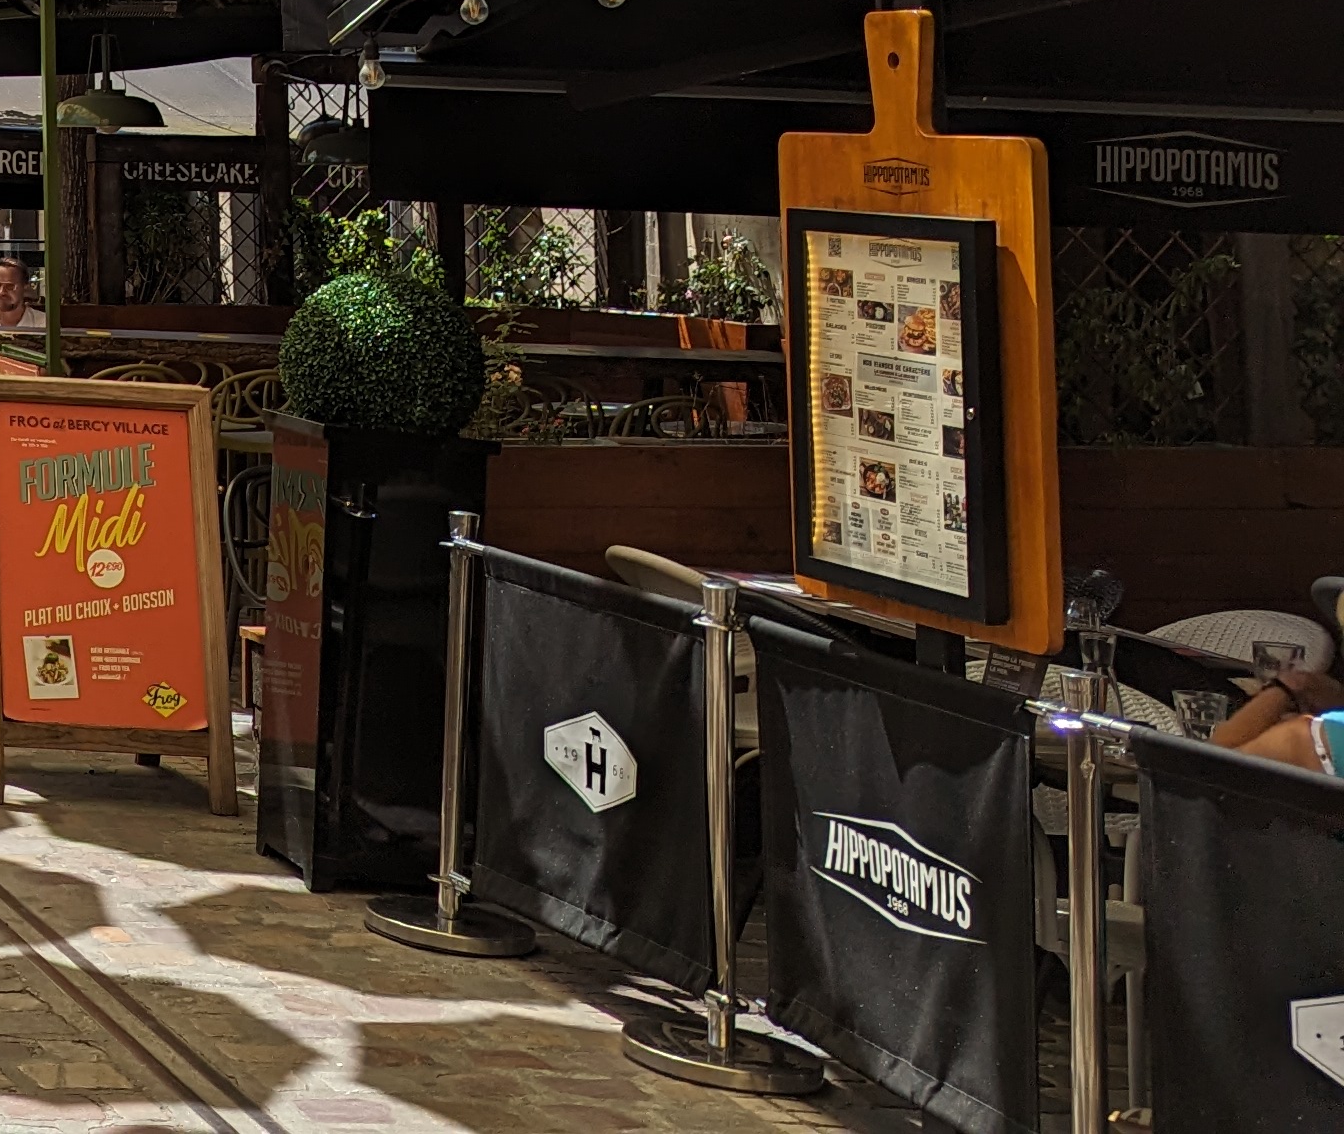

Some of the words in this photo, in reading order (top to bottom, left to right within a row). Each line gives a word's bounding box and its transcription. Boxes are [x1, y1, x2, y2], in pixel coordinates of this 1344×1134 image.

[123, 162, 259, 185] CHEESECAKE
[864, 164, 930, 186] HIPPOPOTAMUS
[1097, 145, 1279, 191] HIPPOPOTAMUS
[1172, 186, 1204, 197] 1968
[9, 415, 50, 429] FROG
[53, 417, 66, 430] at
[68, 419, 110, 432] BERCY
[112, 421, 169, 435] VILLAGE
[20, 443, 156, 504] FORMULE
[34, 483, 147, 572] Midi
[24, 607, 53, 627] PLAT
[56, 604, 72, 623] AU
[76, 598, 111, 620] CHOIX
[123, 589, 175, 613] BOISSON
[147, 683, 181, 707] Frog
[585, 742, 607, 796] H
[824, 819, 971, 930] HIPPOPOTAMUS
[887, 894, 910, 916] 1968
